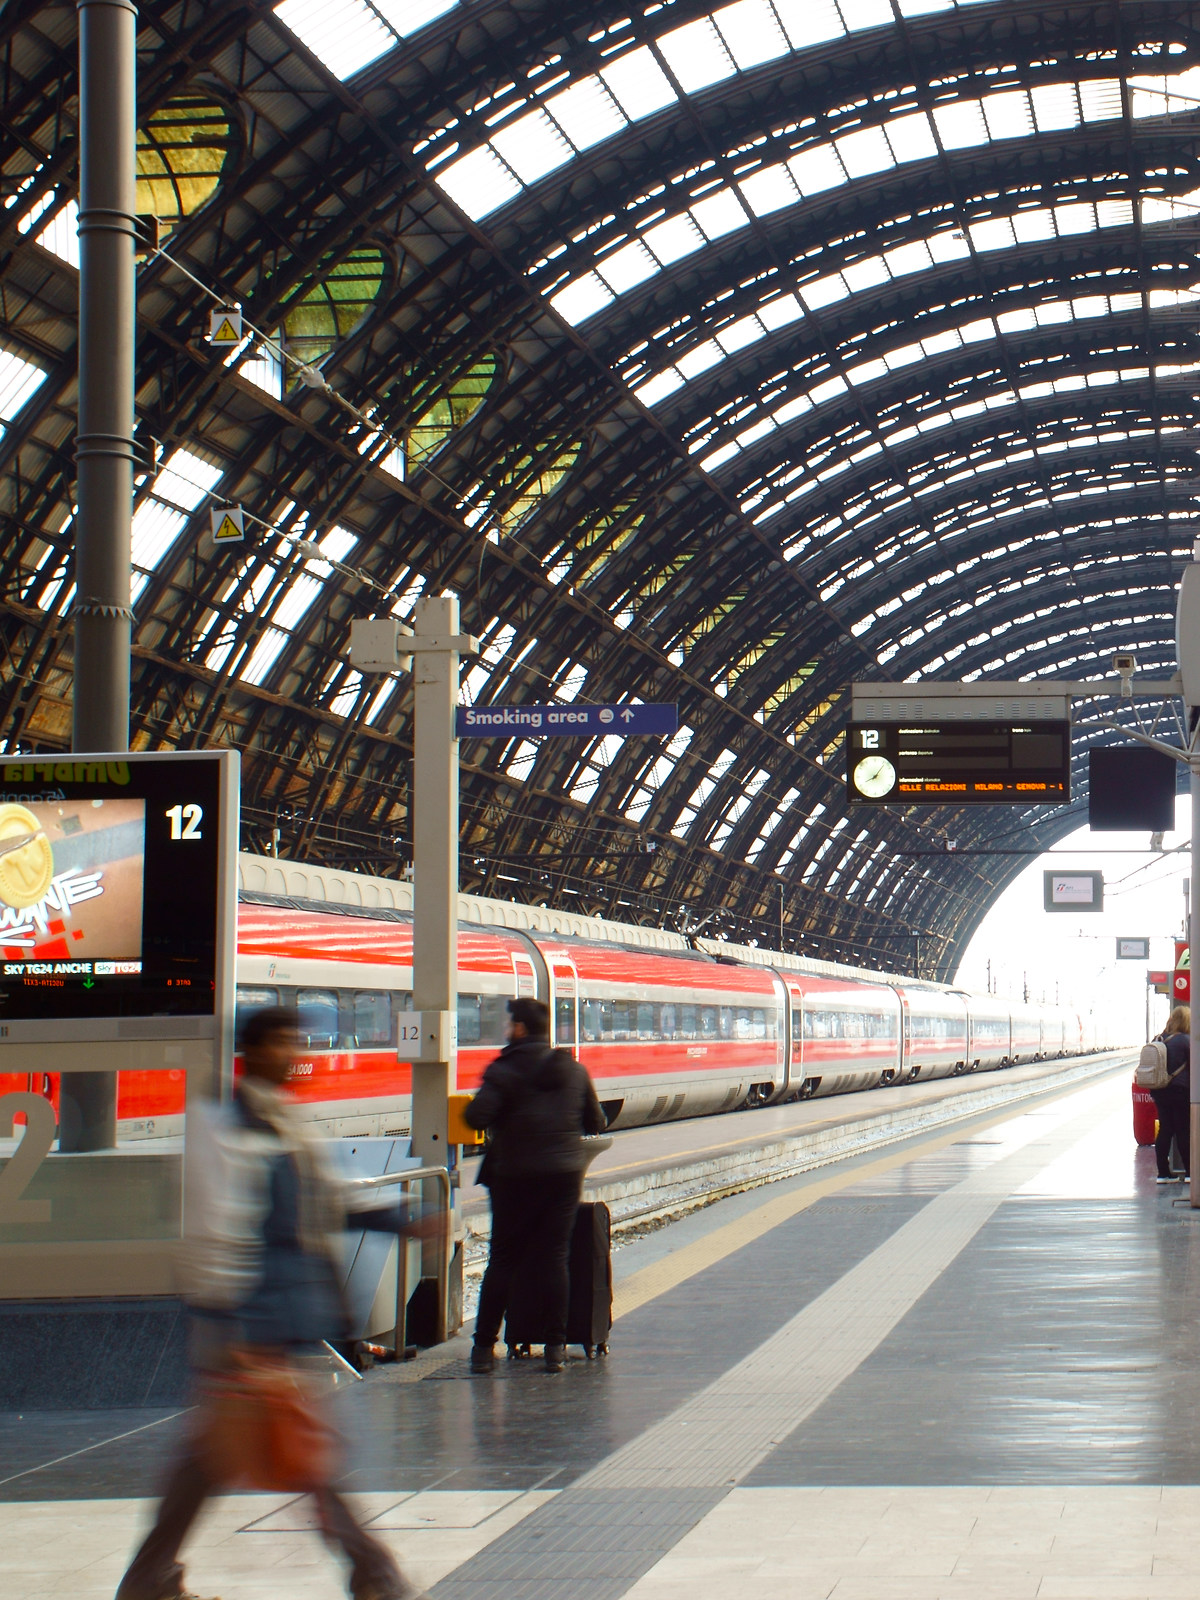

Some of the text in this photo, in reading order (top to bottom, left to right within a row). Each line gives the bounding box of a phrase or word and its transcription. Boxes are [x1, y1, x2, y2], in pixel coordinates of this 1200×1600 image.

[465, 709, 589, 728] Smoking area
[860, 729, 879, 749] 12
[925, 783, 967, 791] RELAZIONI
[974, 783, 1004, 791] MILANO
[165, 803, 204, 841] 12
[4, 963, 92, 975] SKY TG24 ANCHE
[97, 964, 111, 974] sky
[401, 1026, 419, 1041] 12
